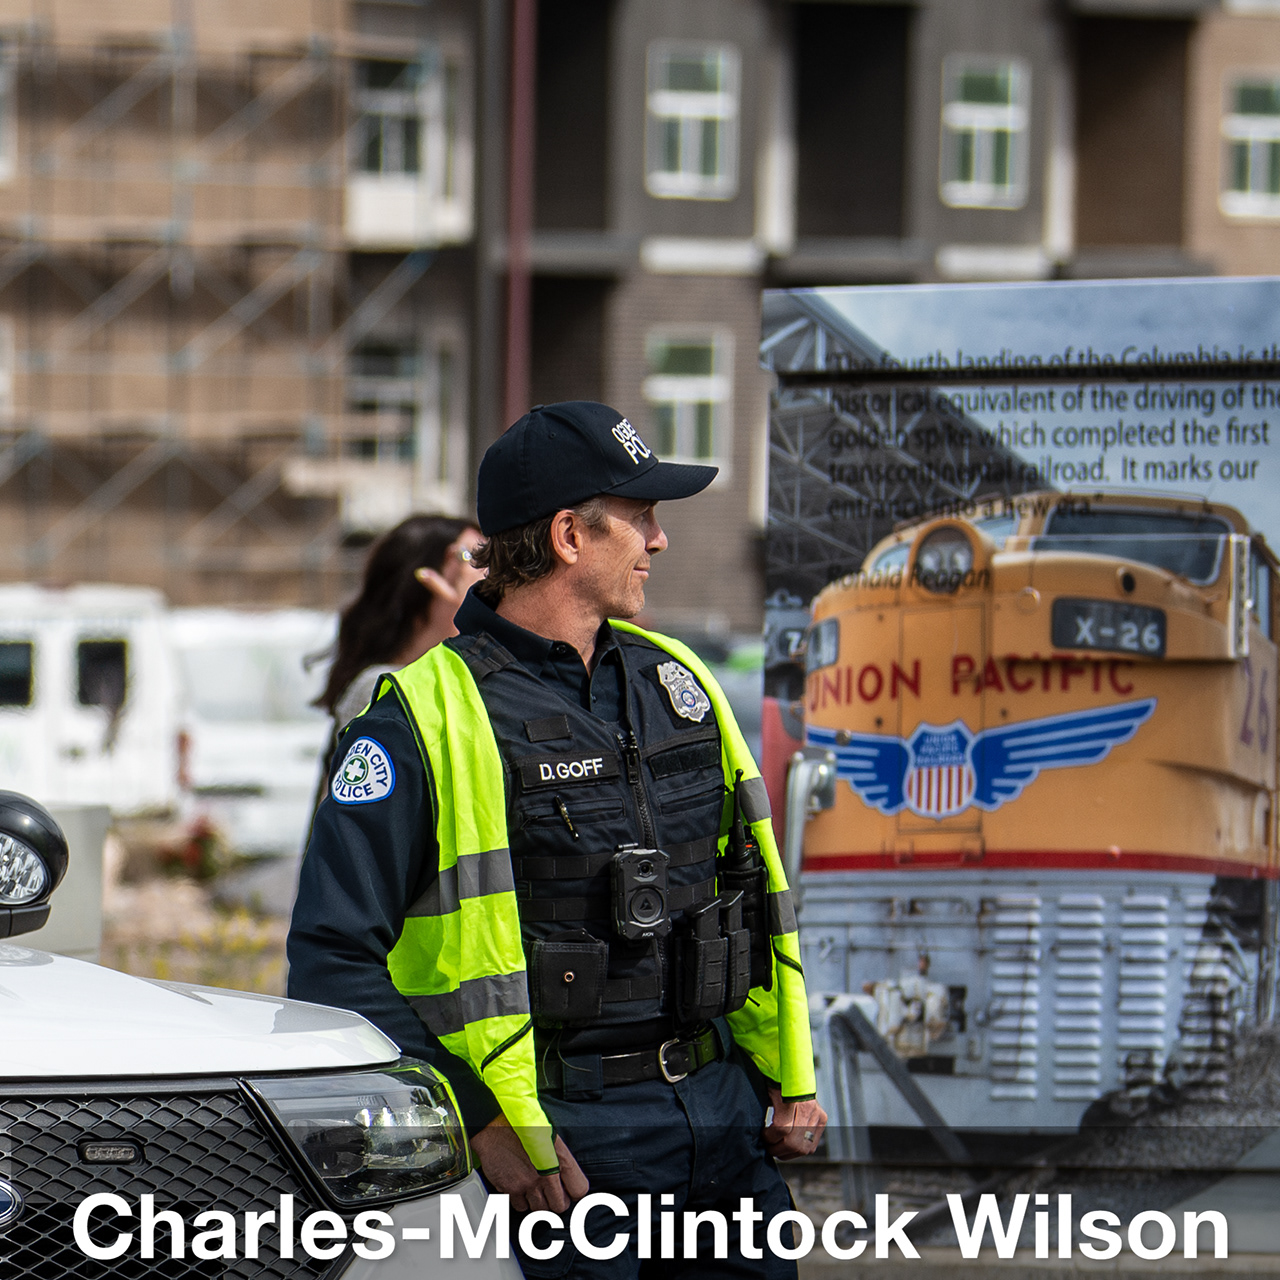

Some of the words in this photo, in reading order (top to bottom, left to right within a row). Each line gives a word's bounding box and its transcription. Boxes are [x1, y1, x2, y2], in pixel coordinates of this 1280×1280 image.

[830, 385, 929, 412] historcal
[939, 384, 1056, 419] equivalent
[1061, 382, 1086, 412] of
[1091, 383, 1128, 412] the
[1134, 382, 1216, 418] driving
[1222, 381, 1246, 410] of
[911, 419, 972, 454] spke
[979, 419, 1046, 447] which
[1051, 419, 1175, 453] completed
[1183, 417, 1221, 446] the
[1226, 416, 1269, 446] first
[1018, 454, 1110, 482] railroad.
[1122, 455, 1137, 482] It
[1143, 453, 1213, 482] marks
[1218, 458, 1259, 481] our
[1075, 615, 1160, 652] X-26
[951, 651, 1134, 697] PACIFIC
[334, 774, 374, 799] POLICE
[370, 753, 388, 788] CITY
